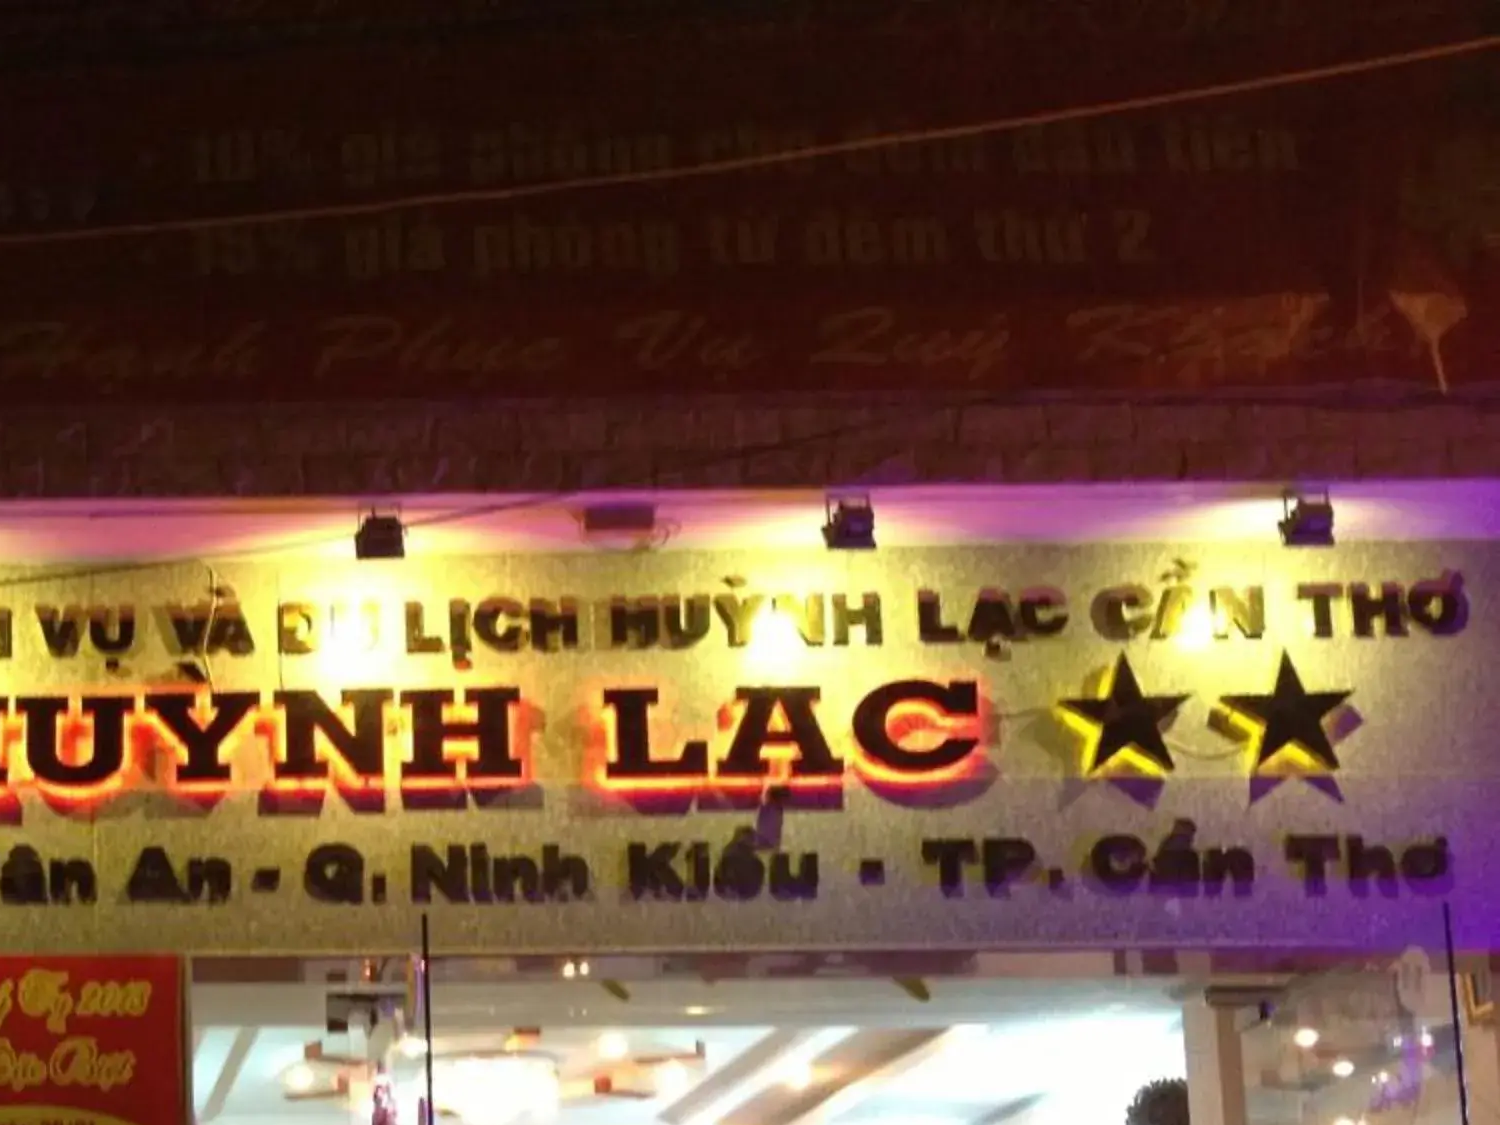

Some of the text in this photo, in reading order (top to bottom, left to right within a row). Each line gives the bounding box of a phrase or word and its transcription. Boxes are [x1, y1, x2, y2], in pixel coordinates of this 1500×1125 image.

[35, 603, 136, 674] VỤ
[405, 594, 578, 672] LỊCH
[915, 586, 1070, 660] LẠC
[1297, 568, 1470, 637] THƠ
[124, 846, 233, 906] An
